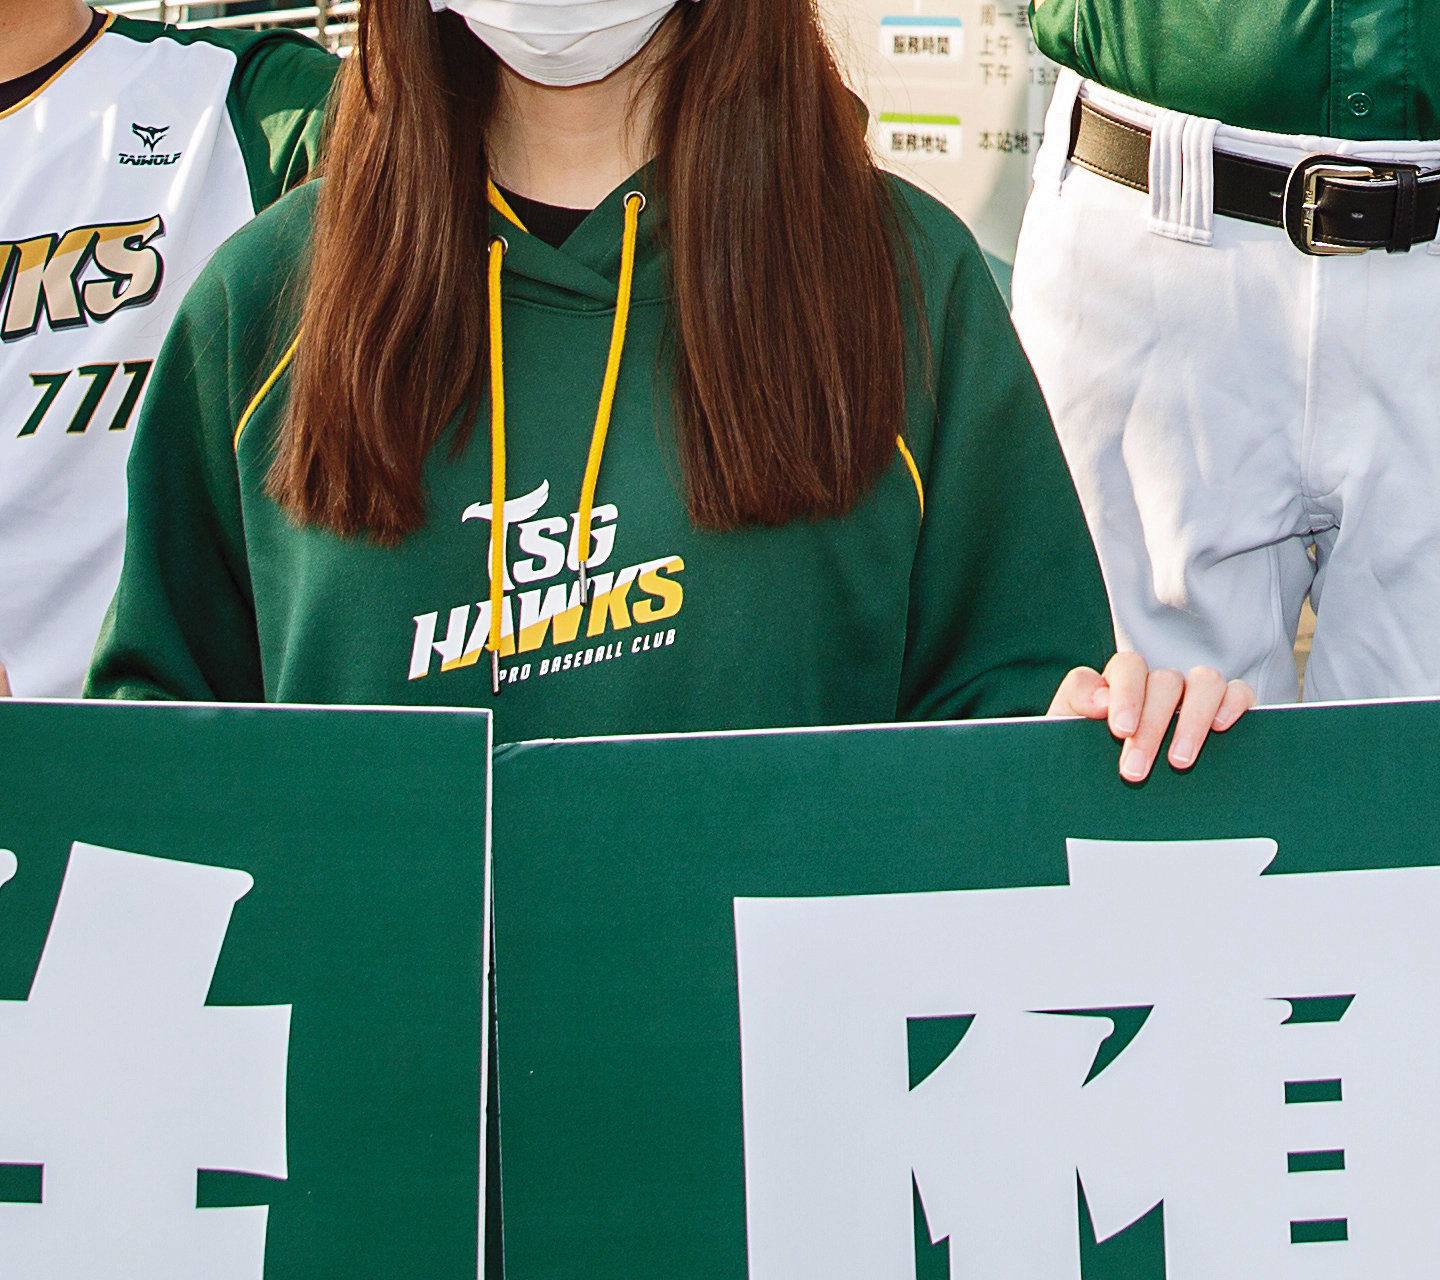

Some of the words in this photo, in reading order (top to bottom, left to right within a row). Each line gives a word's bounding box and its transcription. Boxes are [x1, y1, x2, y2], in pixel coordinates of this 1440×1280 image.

[16, 360, 153, 439] 777
[461, 478, 618, 591] TSG
[408, 554, 685, 681] HAWKS
[539, 640, 623, 678] BASEBALL
[631, 628, 677, 656] CLUB
